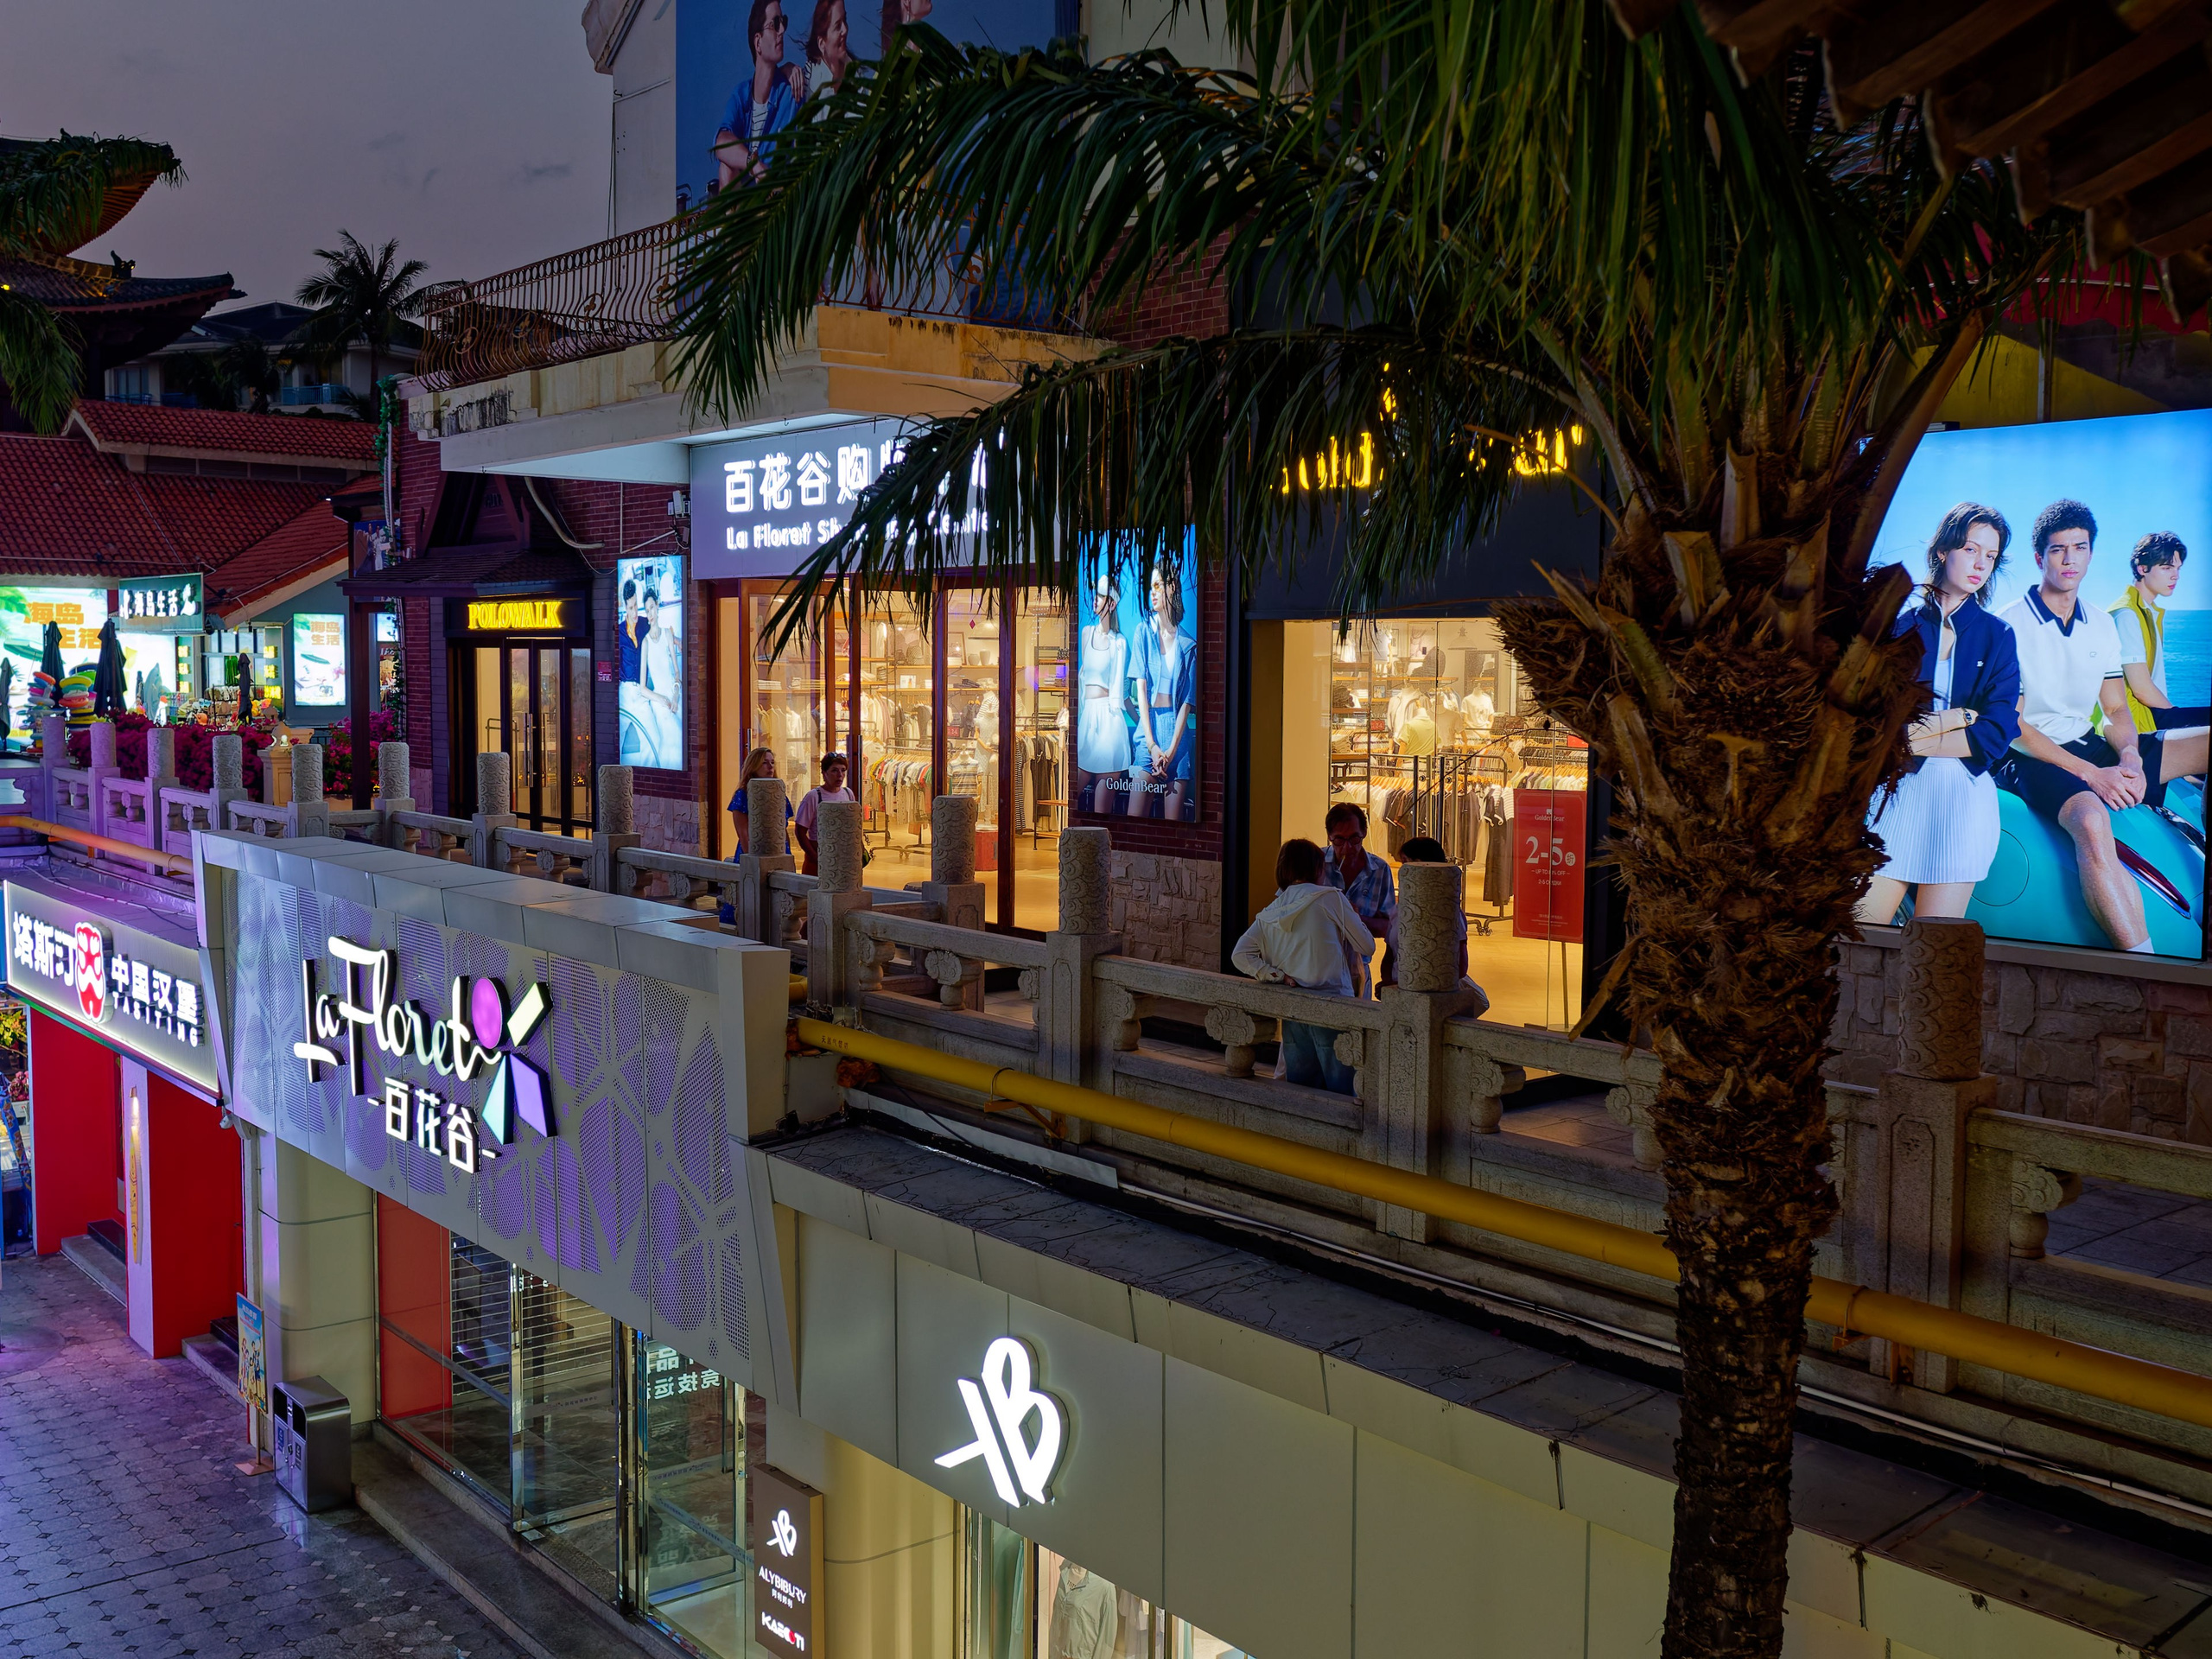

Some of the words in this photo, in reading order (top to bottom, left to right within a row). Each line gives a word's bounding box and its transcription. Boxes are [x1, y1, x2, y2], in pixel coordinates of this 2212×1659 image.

[724, 427, 1006, 513] 百花谷购
[727, 527, 748, 550] La
[753, 522, 812, 548] Floret
[23, 601, 85, 626] 海岛
[310, 620, 340, 633] 海岛
[467, 601, 564, 630] POLOWALK
[311, 634, 340, 646] 生活
[1105, 776, 1167, 795] GoldenBear
[13, 910, 76, 987] 塔斯汀
[111, 953, 198, 1026] 中国汉堡
[111, 991, 198, 1048] TASITING
[328, 936, 501, 1096] Floret
[385, 1077, 474, 1174] 百花谷
[759, 1565, 807, 1605] ALYBIBURY
